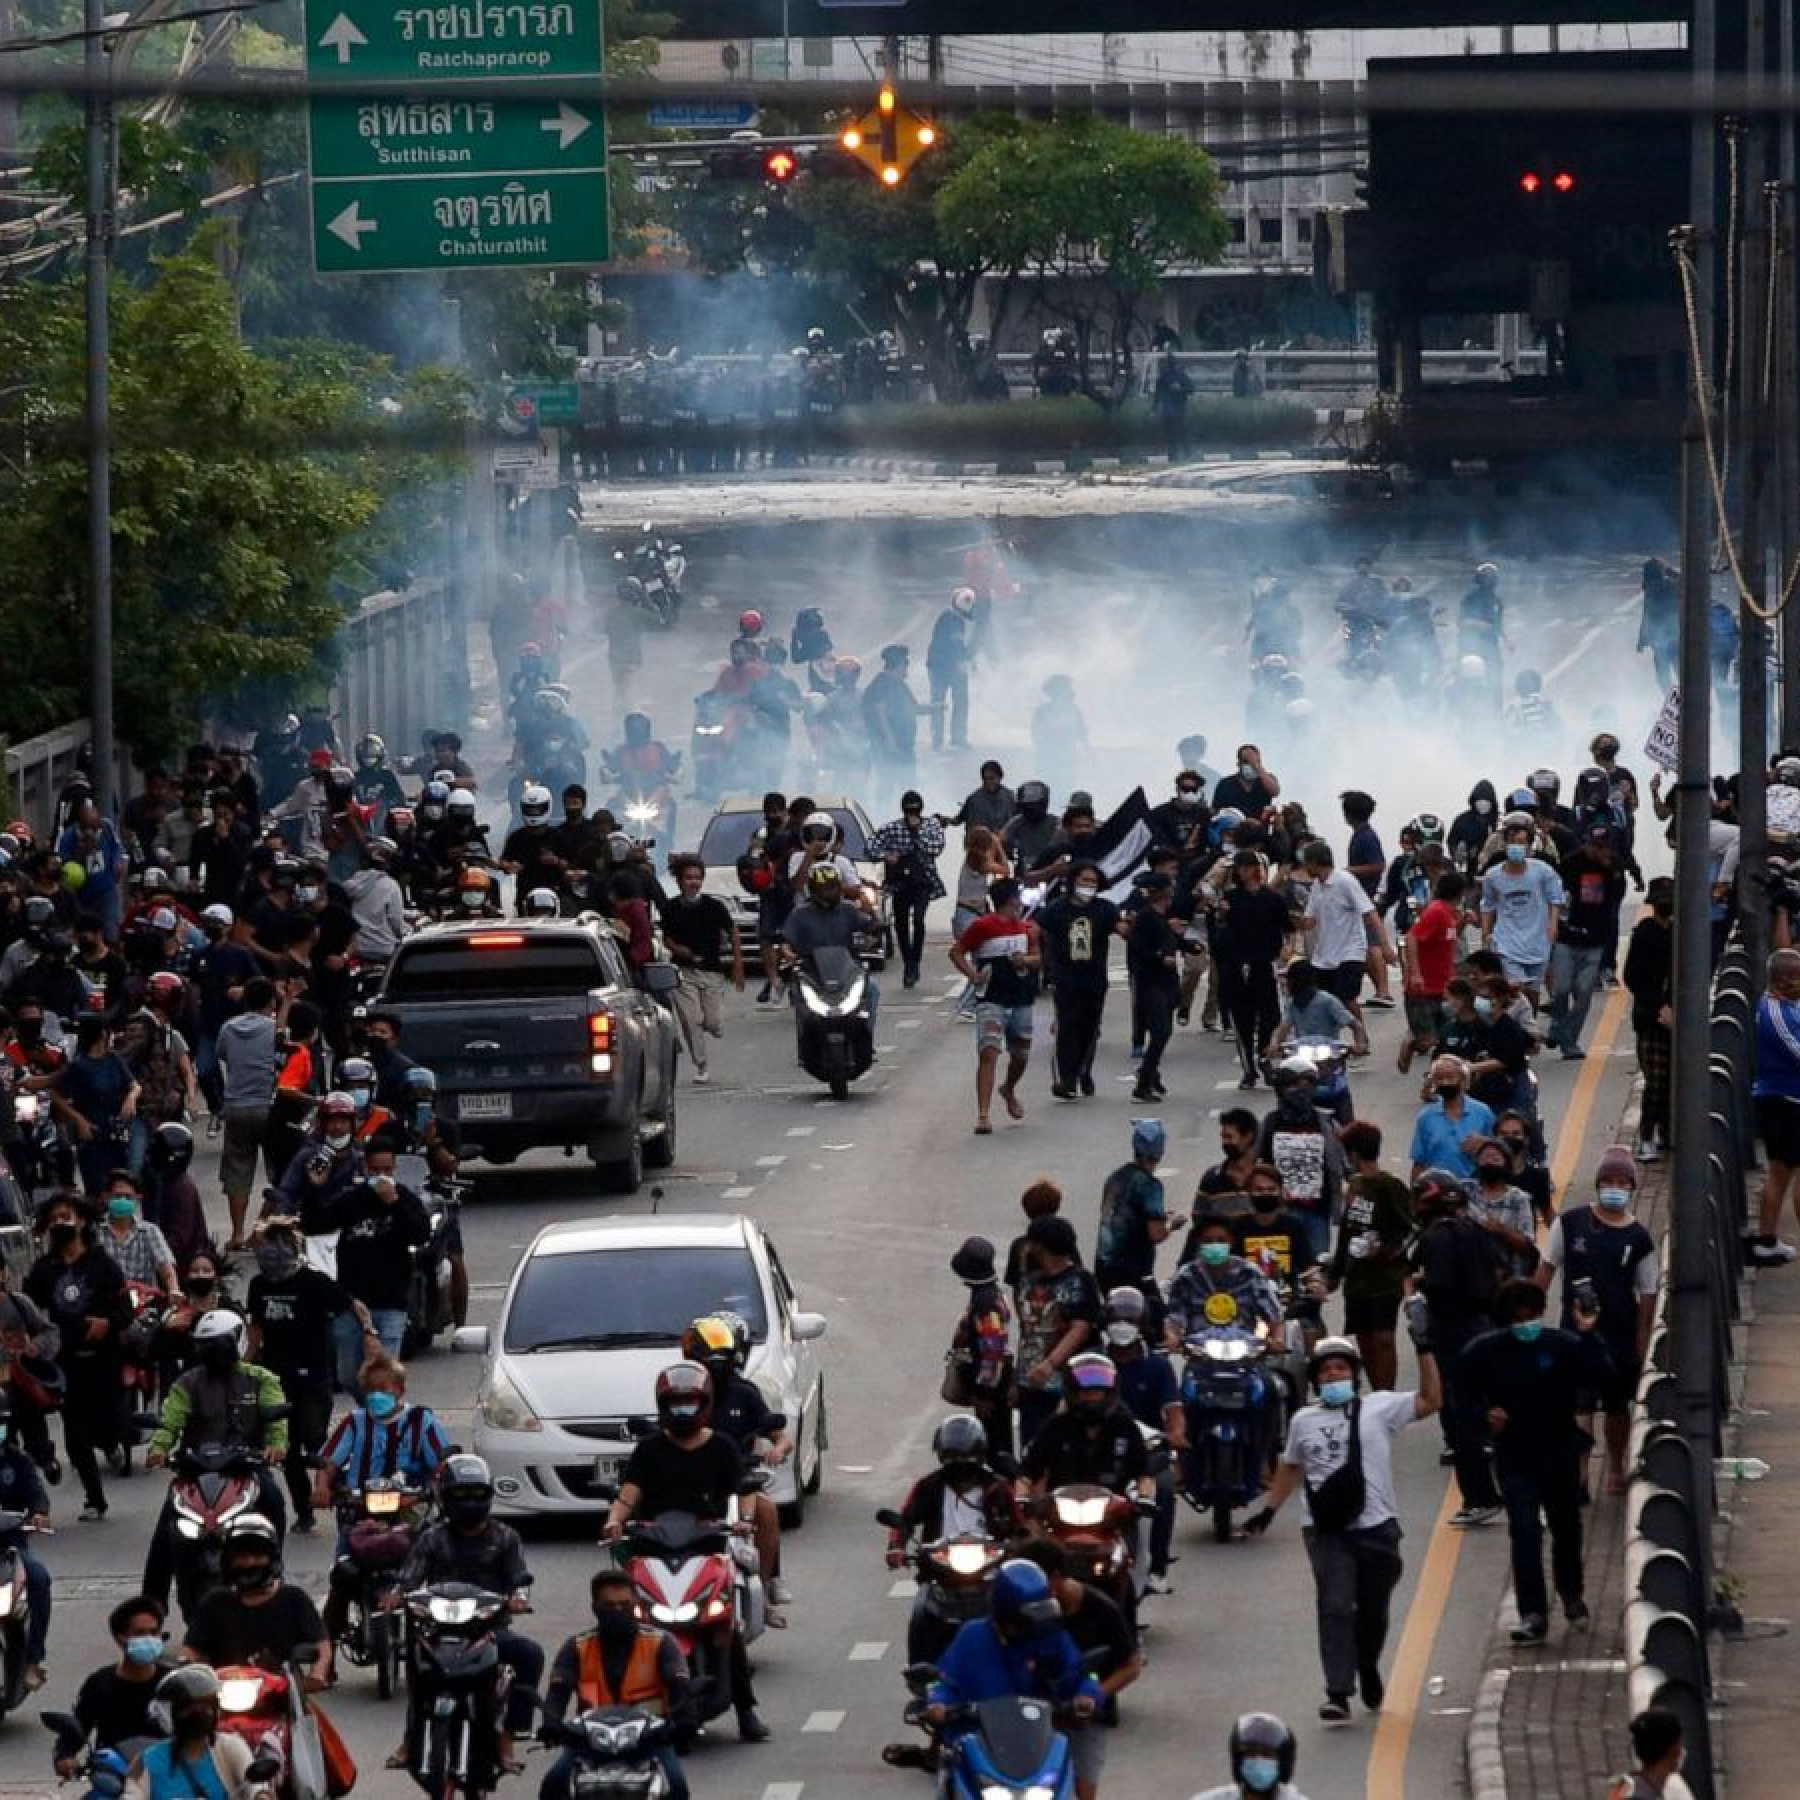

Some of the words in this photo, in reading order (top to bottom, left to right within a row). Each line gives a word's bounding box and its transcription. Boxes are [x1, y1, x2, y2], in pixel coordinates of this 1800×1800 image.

[394, 0, 574, 40] ราชปรารภ
[419, 51, 550, 68] Ratchaprarop
[378, 148, 471, 164] Sutthisan
[432, 182, 552, 238] จตุรทิศ
[438, 238, 548, 256] Chaturathit
